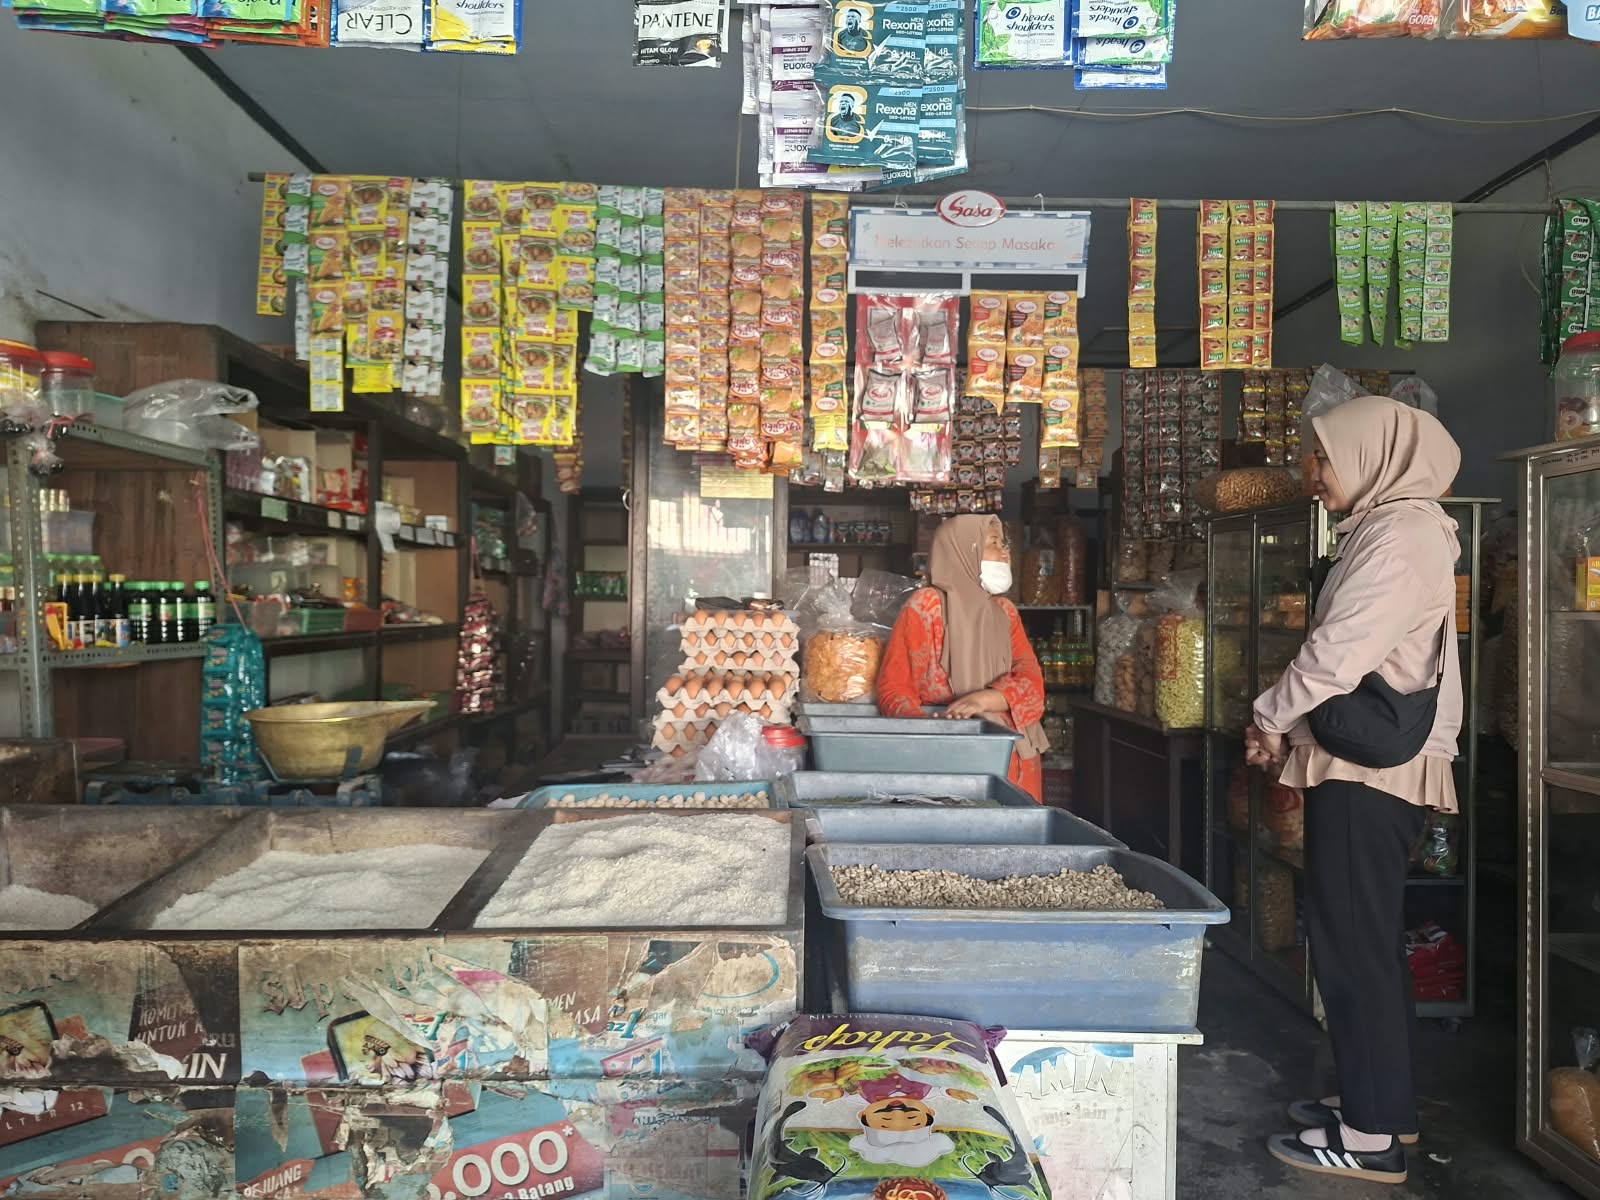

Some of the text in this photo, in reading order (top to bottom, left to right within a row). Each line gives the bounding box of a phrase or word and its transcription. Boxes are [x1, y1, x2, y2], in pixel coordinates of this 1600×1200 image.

[1089, 5, 1138, 14] shoulders
[346, 13, 413, 35] CLEAR
[642, 12, 714, 29] PANTENE
[882, 18, 924, 31] Rexona
[927, 18, 954, 27] xona
[1006, 21, 1055, 32] shoulders
[875, 103, 917, 116] Rexona
[921, 102, 953, 112] exona
[948, 195, 993, 219] Sasa
[137, 1021, 187, 1046] UNTUK
[797, 1023, 977, 1057] Lahap
[70, 1101, 85, 1112] 12
[516, 1175, 576, 1200] Batang
